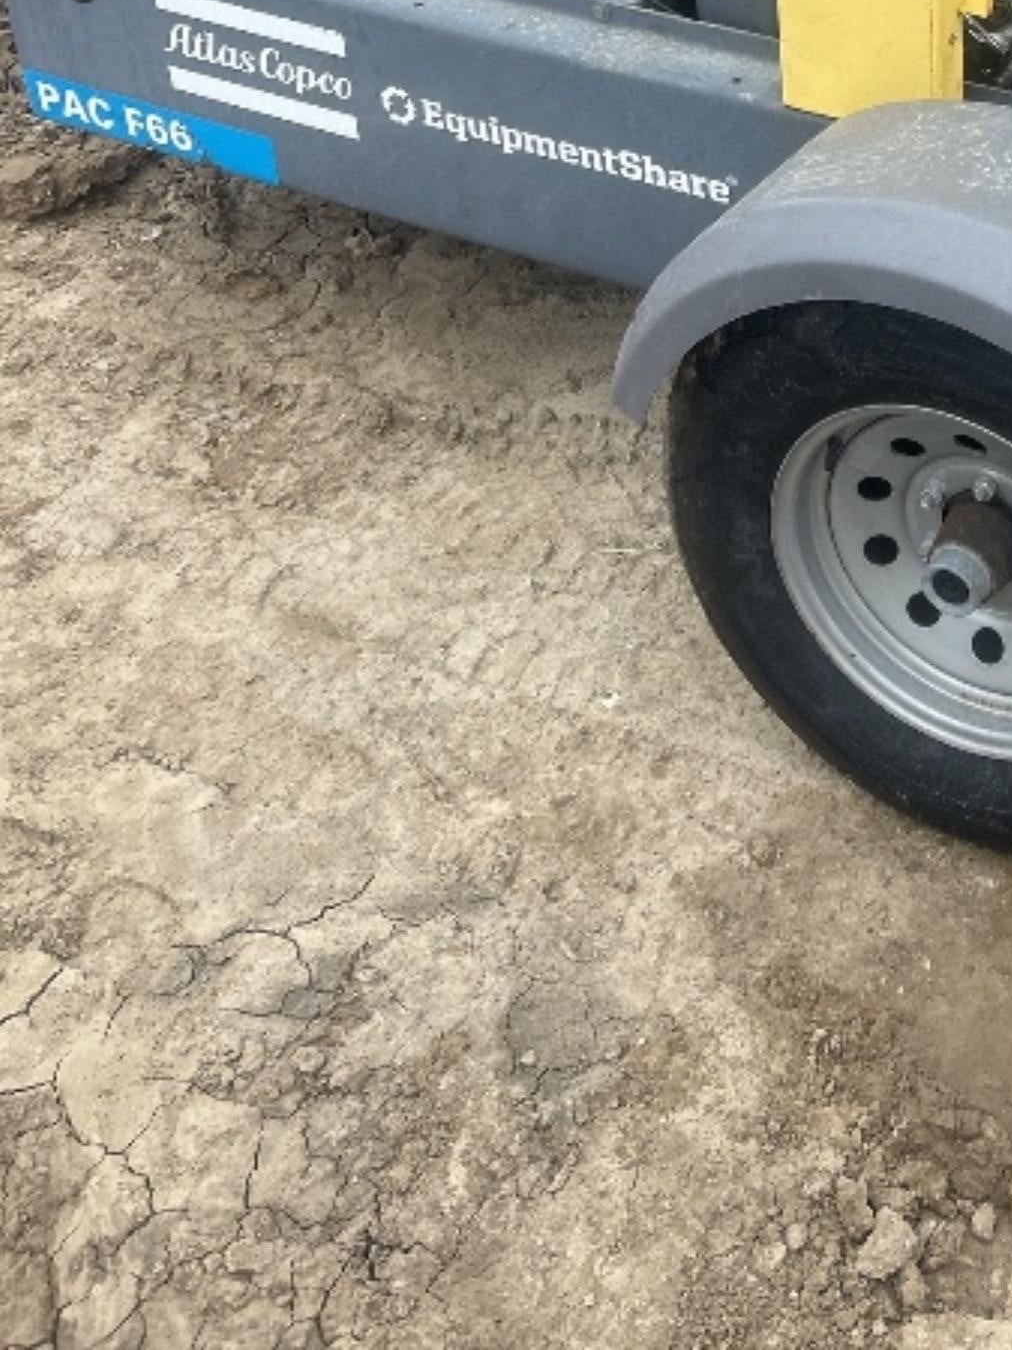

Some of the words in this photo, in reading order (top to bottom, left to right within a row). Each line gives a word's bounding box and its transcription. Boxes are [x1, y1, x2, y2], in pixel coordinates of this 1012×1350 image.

[164, 23, 255, 73] Atlas
[259, 47, 351, 99] Copco
[35, 80, 114, 130] PAC
